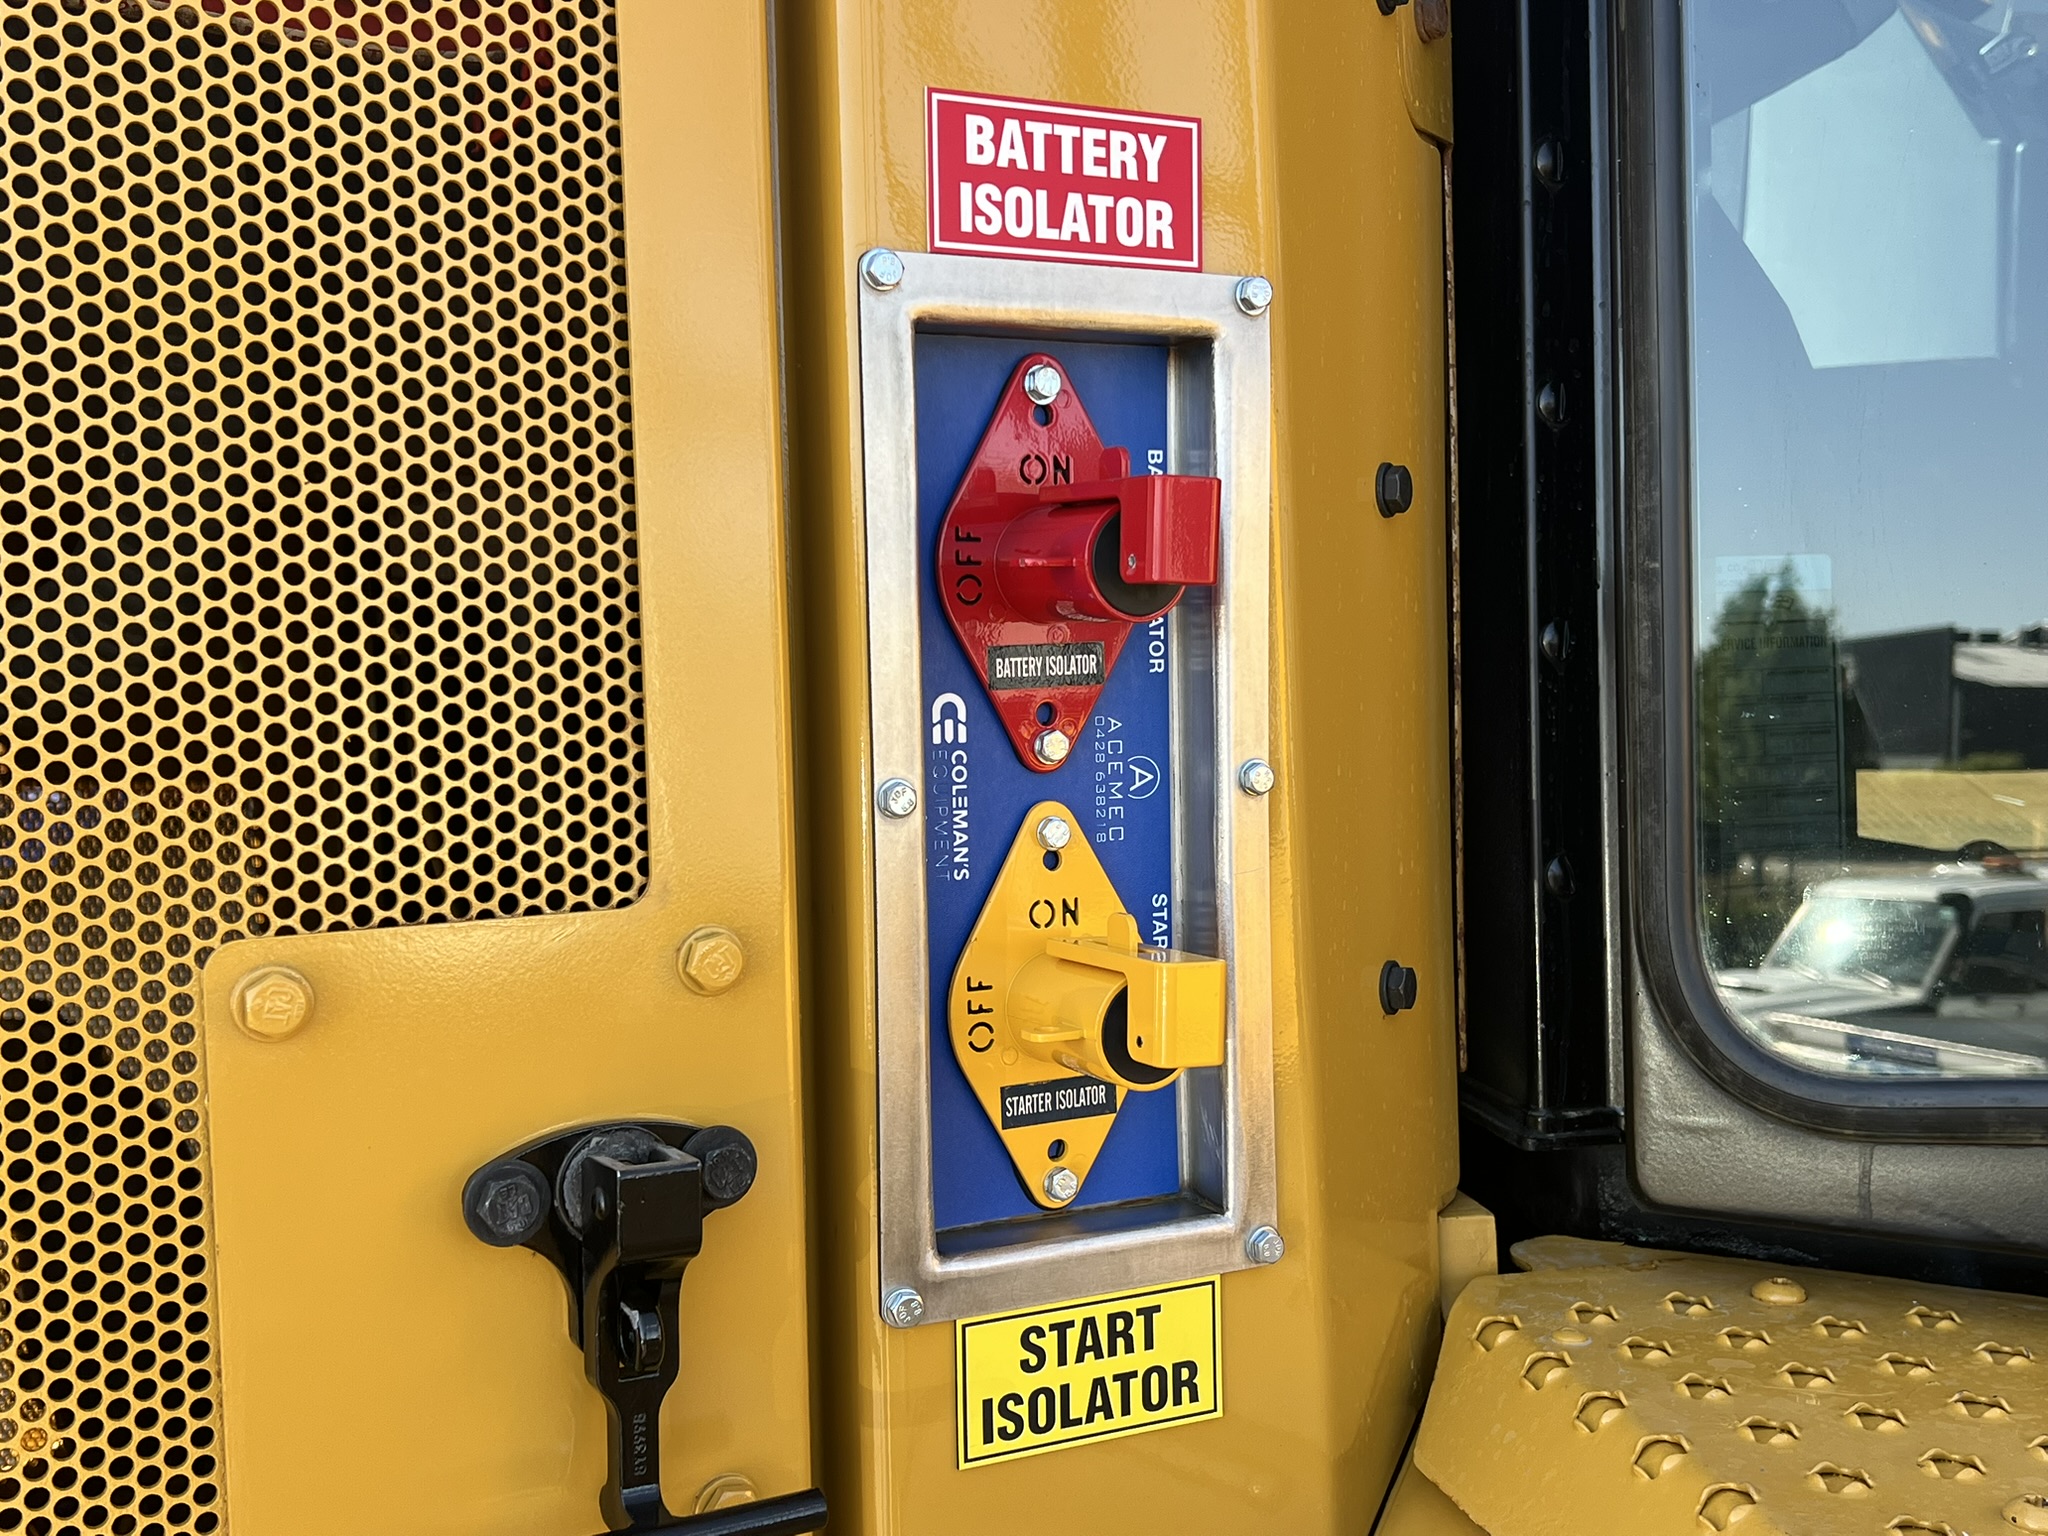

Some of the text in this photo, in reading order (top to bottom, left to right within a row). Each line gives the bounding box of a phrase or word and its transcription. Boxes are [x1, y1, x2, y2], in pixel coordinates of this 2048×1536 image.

[965, 113, 1168, 183] BATTERY
[959, 181, 1175, 250] ISOLATOR
[1019, 454, 1074, 486] ON
[955, 525, 983, 606] OFF
[995, 653, 1098, 679] BATTERY ISOLATOR
[1149, 617, 1165, 673] ATOR
[1094, 715, 1107, 843] 0428 638218
[1107, 716, 1125, 841] ACEMEC
[932, 750, 950, 881] EQUIPMENT
[951, 749, 970, 881] COLEMAN'S
[1029, 897, 1079, 929] ON
[1151, 893, 1168, 949] STAR
[966, 976, 995, 1053] OFF
[1005, 1084, 1107, 1117] STARTER ISOLATOR
[1019, 1304, 1162, 1374] START
[981, 1359, 1200, 1446] ISOLATOR
